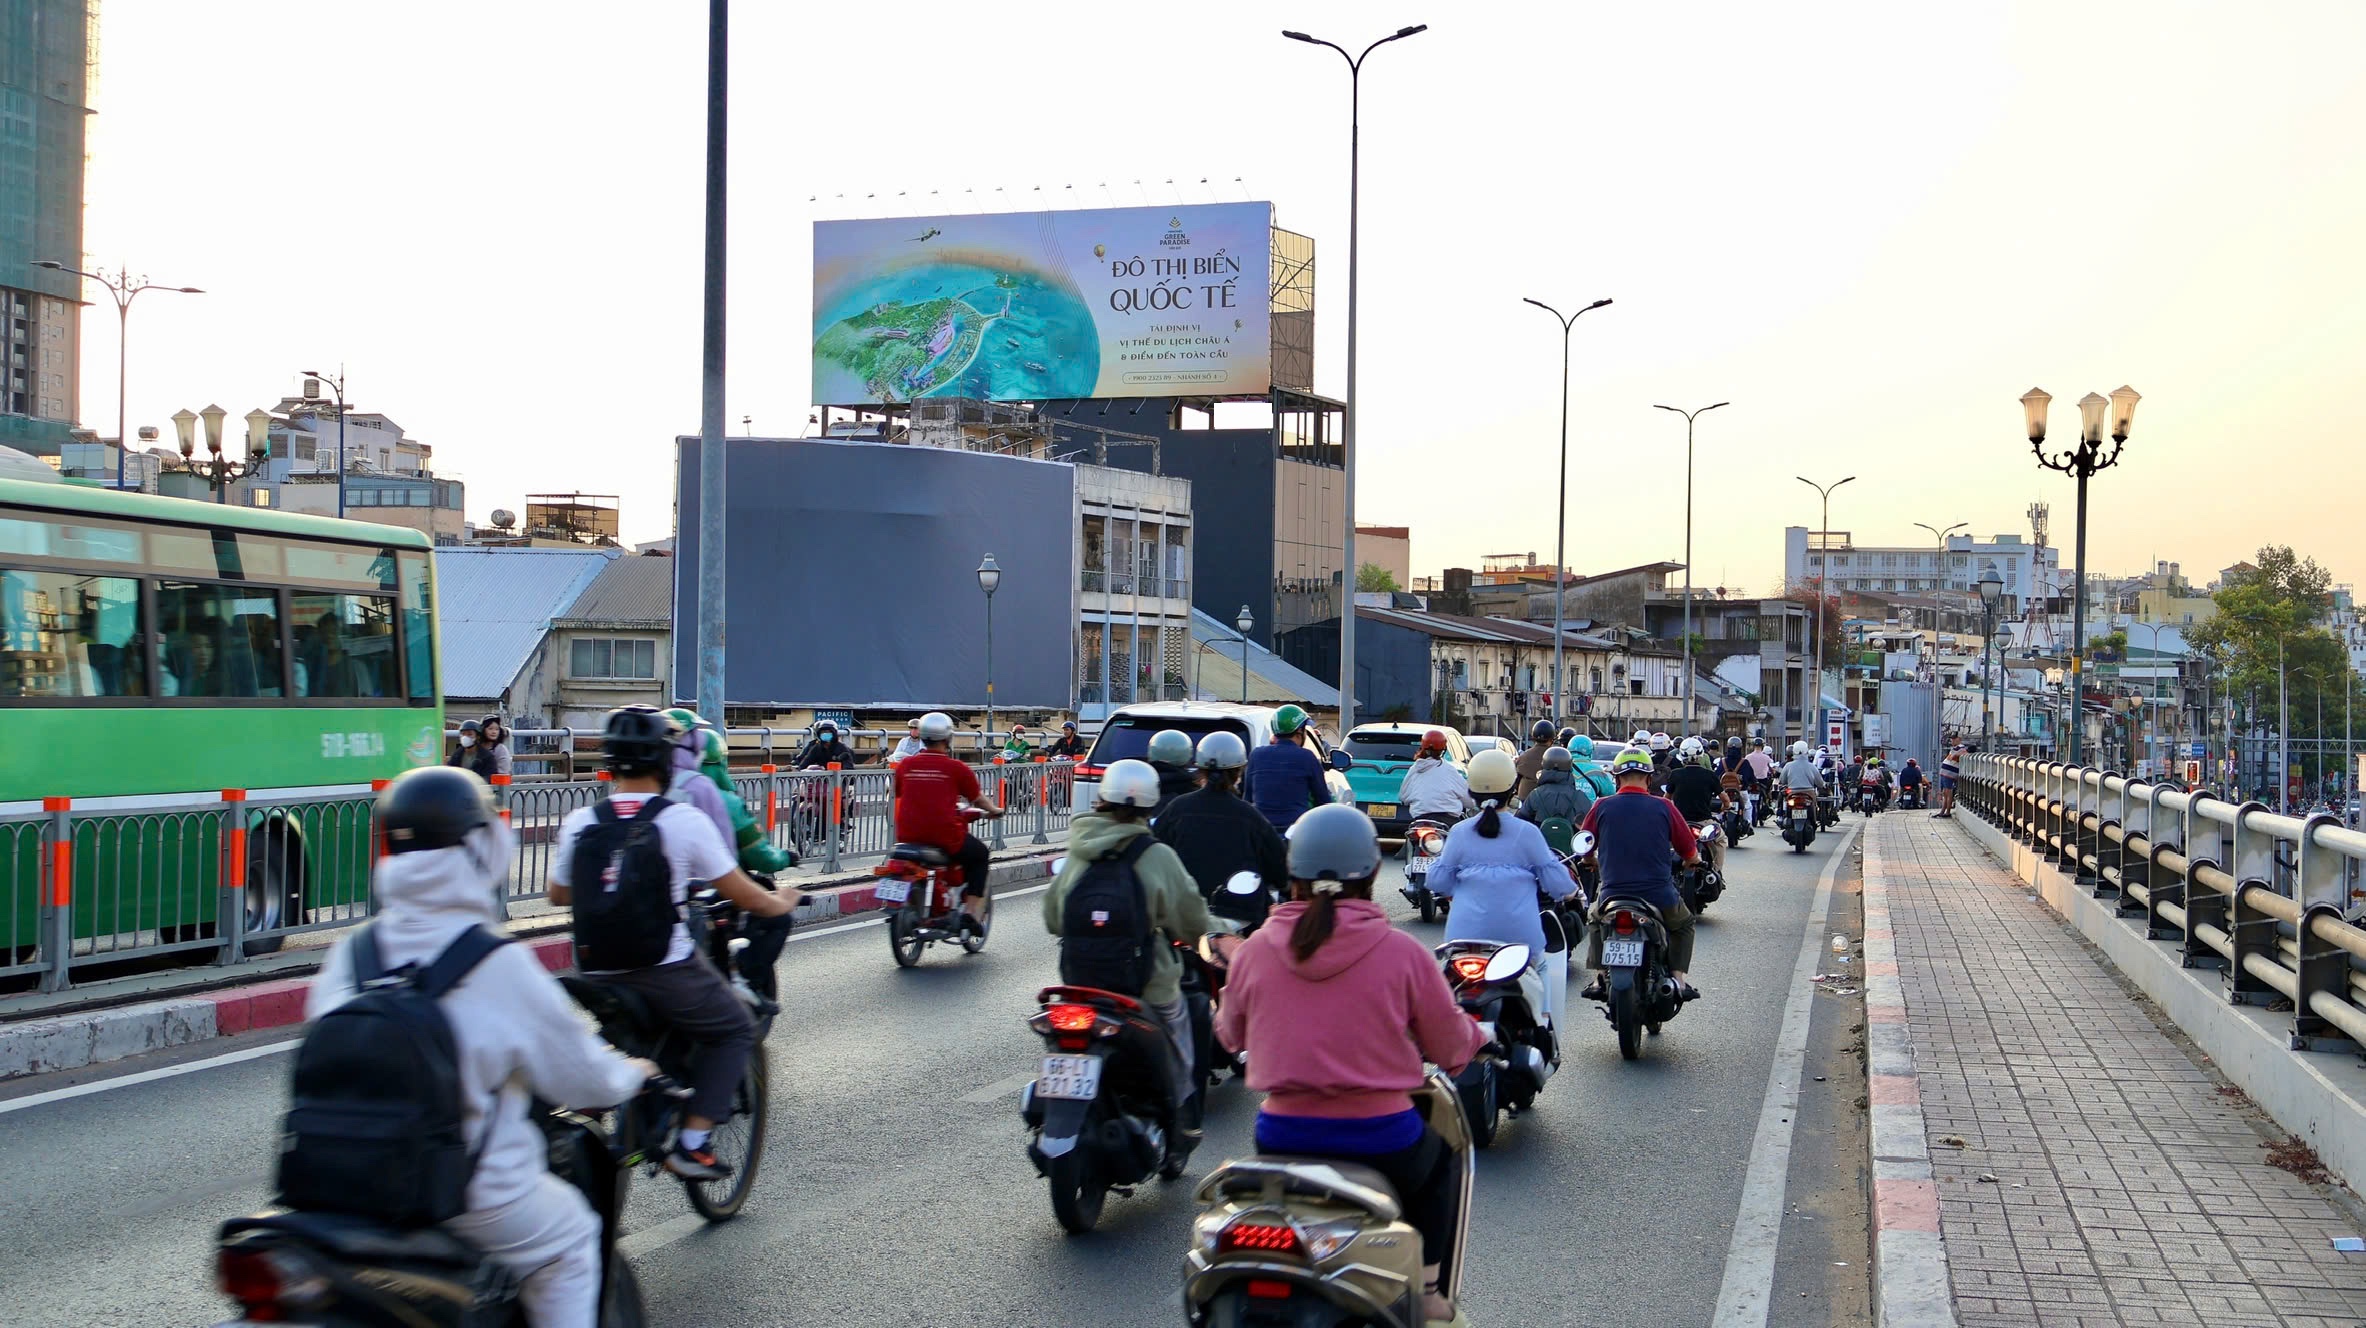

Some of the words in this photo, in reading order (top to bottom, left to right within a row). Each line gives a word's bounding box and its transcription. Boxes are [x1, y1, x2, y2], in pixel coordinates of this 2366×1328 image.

[1112, 255, 1145, 278] ĐÔ
[1151, 258, 1187, 280] THỊ
[1194, 248, 1240, 275] BIỂN
[1110, 278, 1192, 316] QUỐC
[1200, 276, 1240, 309] TẾ
[1150, 323, 1163, 332] TÁI
[1166, 324, 1189, 334] ĐỊNH
[1192, 323, 1201, 333] VỊ
[1119, 339, 1129, 349] VỊ
[1132, 336, 1152, 347] THẾ
[1153, 338, 1167, 346] DU
[1169, 337, 1192, 347] LỊCH
[1195, 335, 1221, 345] CHÂU
[1223, 335, 1231, 345] Á
[1157, 350, 1176, 360] ĐẾN
[1180, 350, 1206, 359] TOÀN
[1210, 349, 1229, 359] CẦU
[1609, 942, 1636, 953] 59-T1
[1605, 952, 1640, 965] 075.15
[1048, 1058, 1089, 1076] 66-L1
[1040, 1076, 1094, 1097] 621.32
